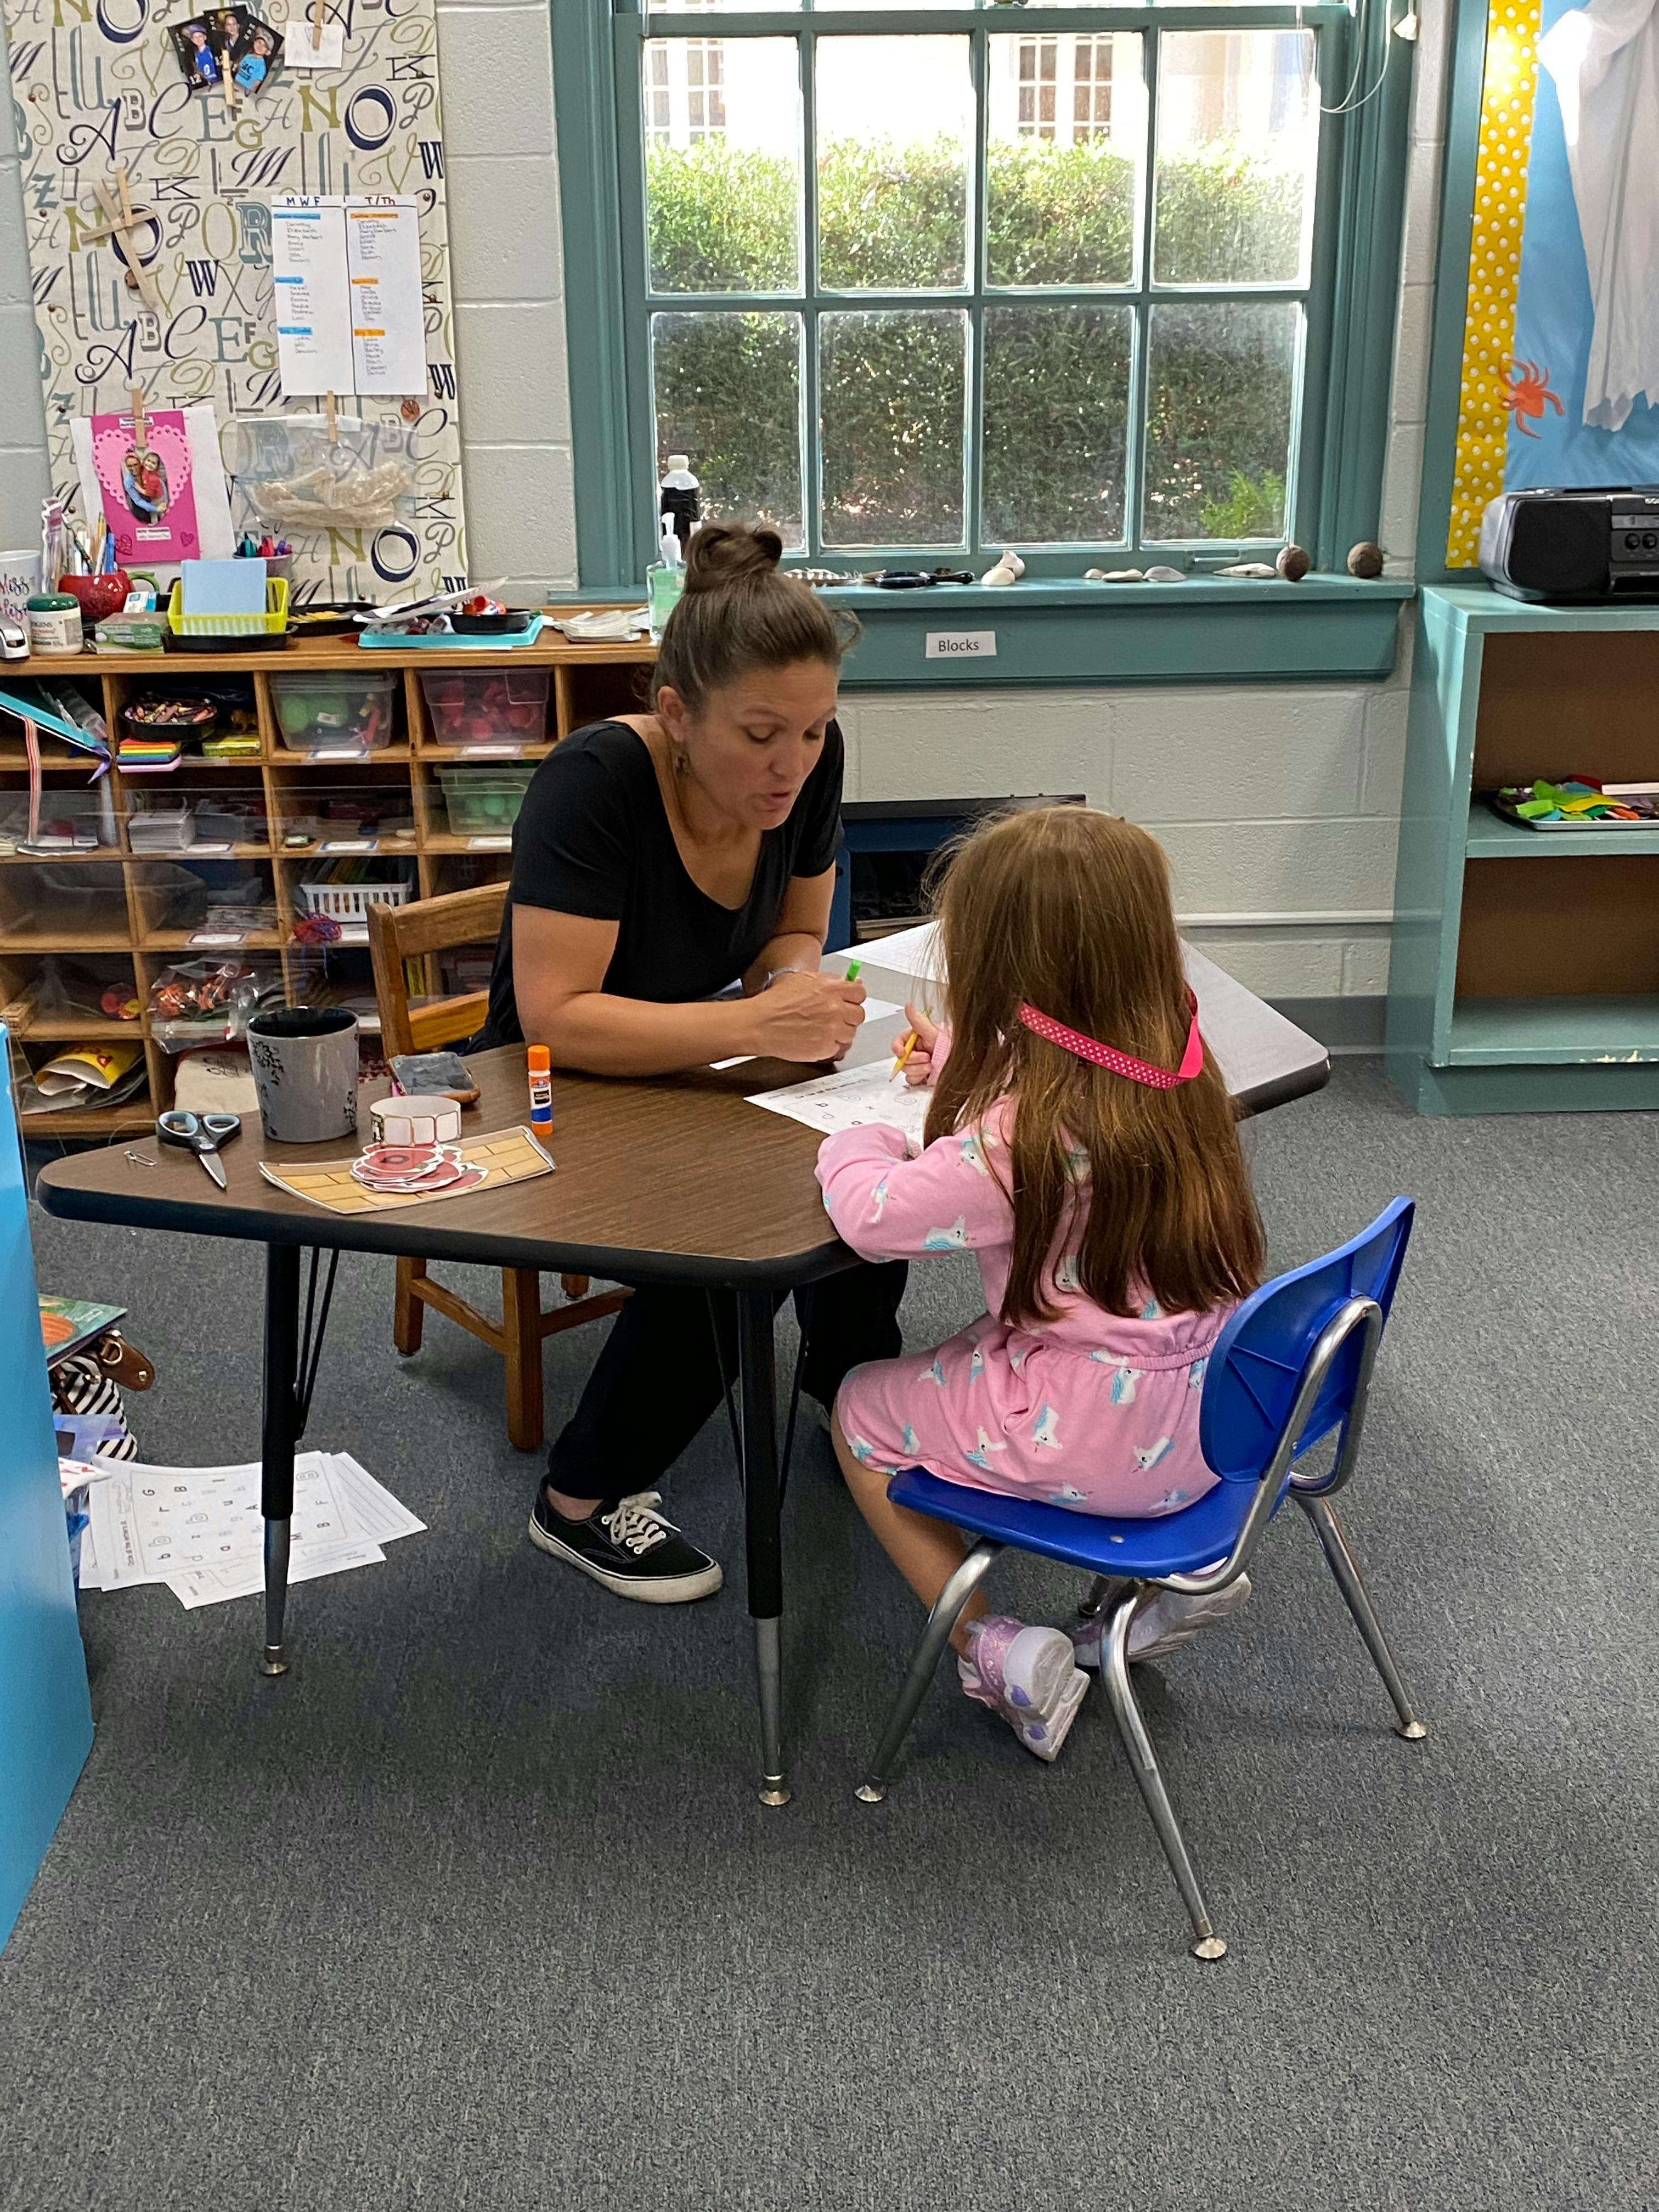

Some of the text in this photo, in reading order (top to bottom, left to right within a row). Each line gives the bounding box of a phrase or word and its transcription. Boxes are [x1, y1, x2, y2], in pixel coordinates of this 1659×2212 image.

[121, 88, 146, 131] B
[297, 85, 341, 132] N
[345, 84, 397, 150] O
[57, 98, 121, 165] A
[234, 119, 263, 150] G
[286, 196, 320, 206] M W F
[185, 260, 219, 296] W
[76, 320, 136, 384] A
[138, 311, 161, 351] B
[208, 317, 247, 363] E
[245, 321, 257, 344] F
[371, 521, 420, 582] O
[939, 639, 979, 652] Blocks
